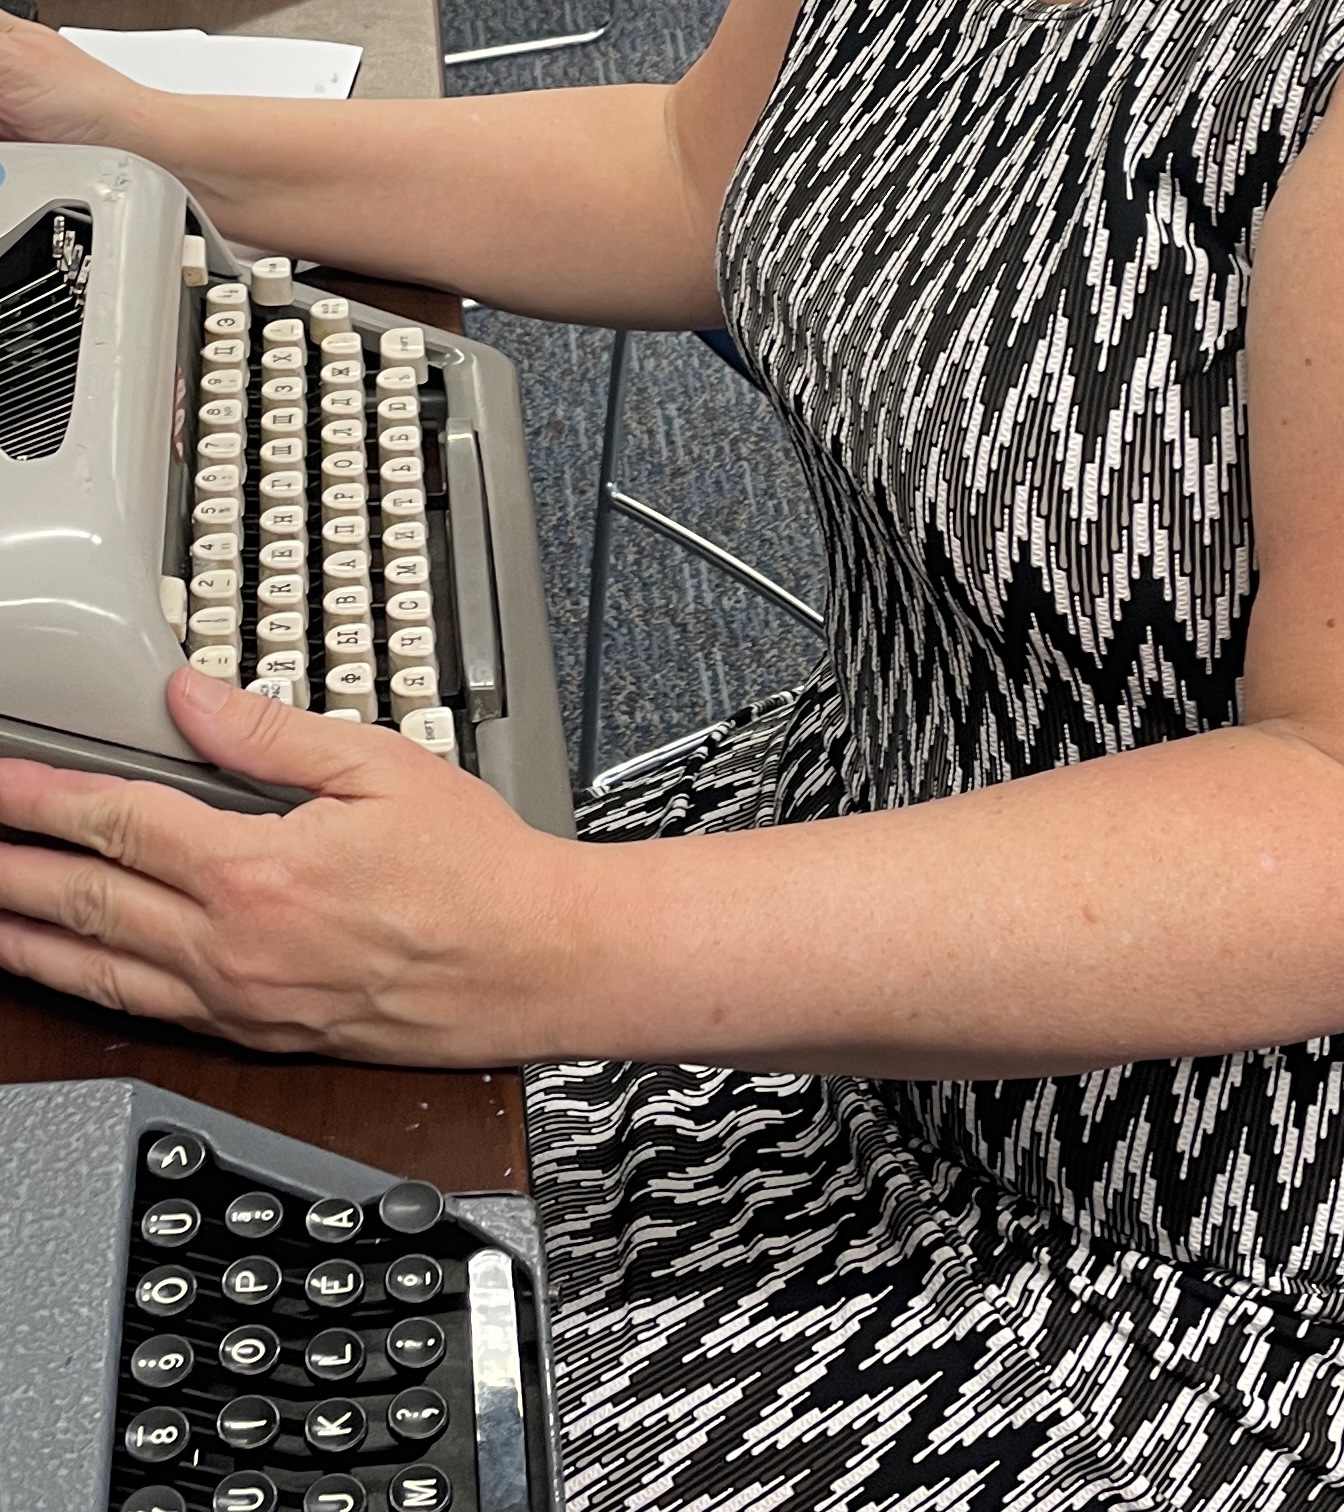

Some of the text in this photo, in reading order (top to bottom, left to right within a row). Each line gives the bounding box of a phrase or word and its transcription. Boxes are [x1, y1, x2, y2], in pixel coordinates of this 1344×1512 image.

[337, 631, 358, 644] Ы
[267, 660, 295, 671] Й
[341, 673, 360, 684] Ф
[311, 1208, 355, 1229] Á
[142, 1213, 192, 1305] Ö Ü
[235, 1271, 269, 1292] P
[312, 1273, 354, 1294] É
[231, 1338, 267, 1364] O
[320, 1343, 351, 1366] L
[317, 1411, 353, 1436] K
[403, 1478, 438, 1507] M
